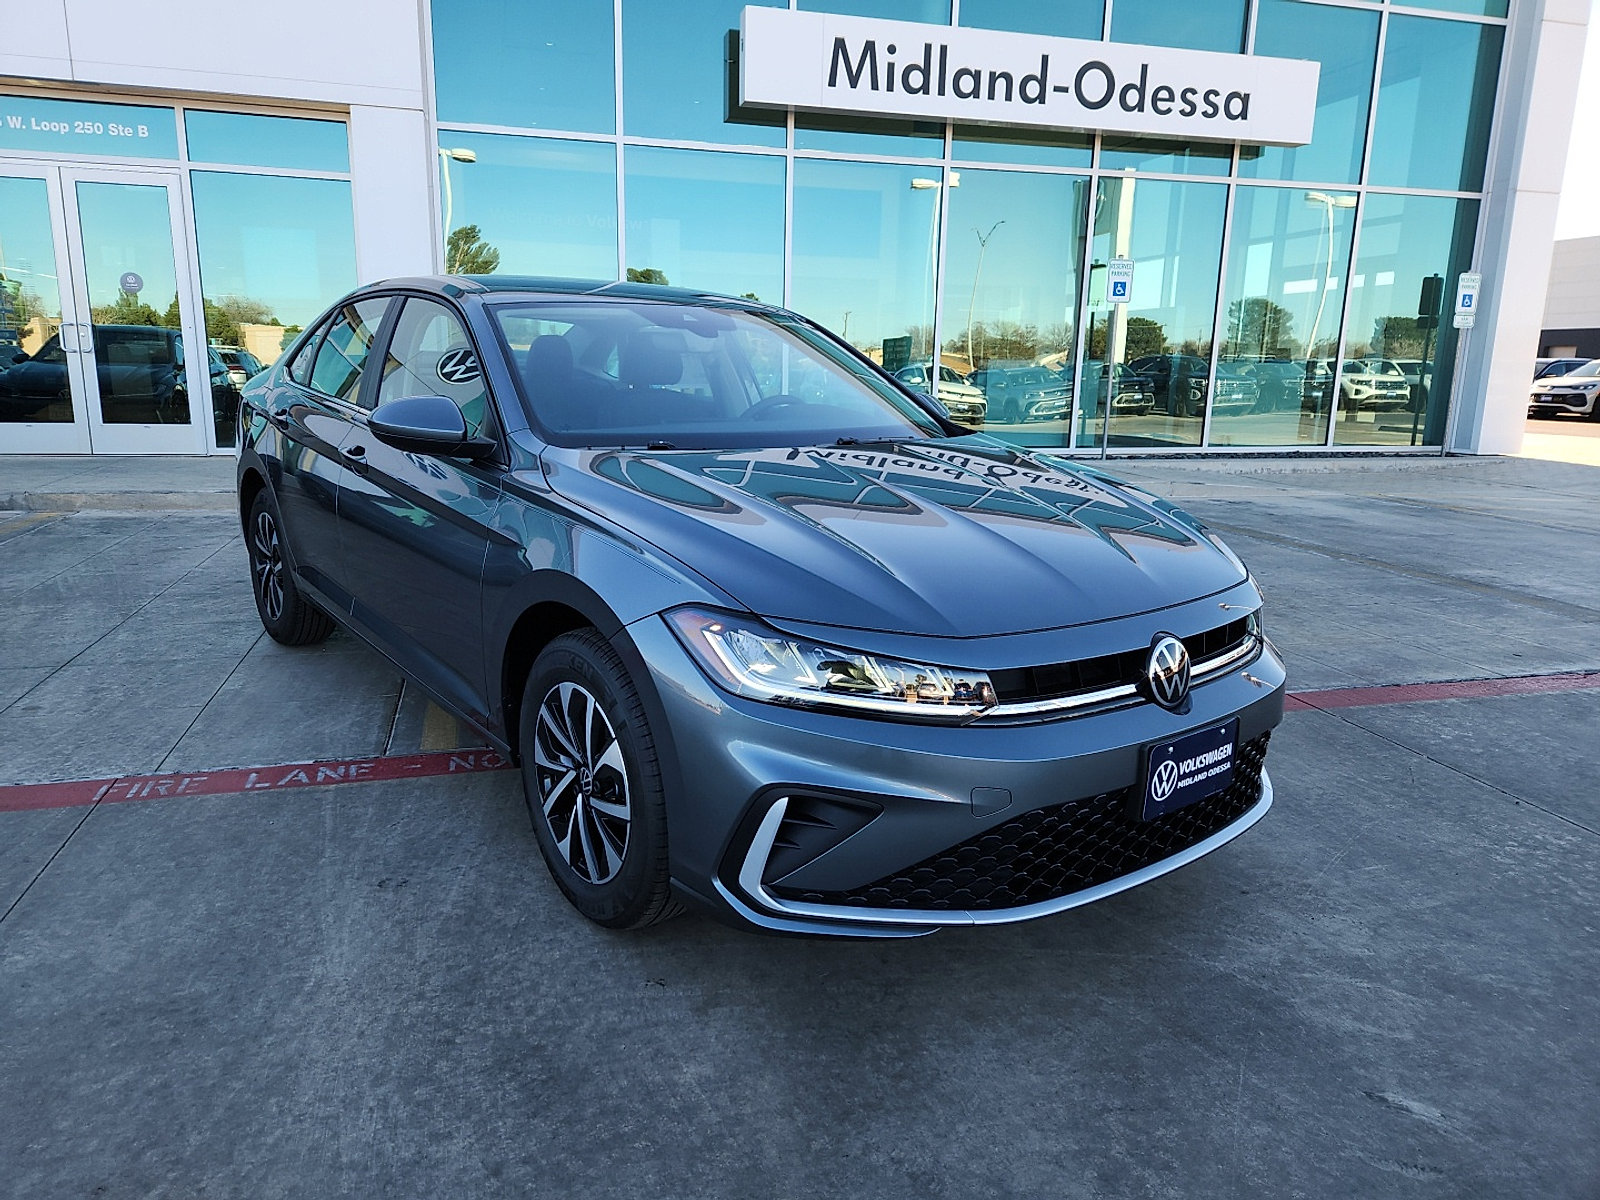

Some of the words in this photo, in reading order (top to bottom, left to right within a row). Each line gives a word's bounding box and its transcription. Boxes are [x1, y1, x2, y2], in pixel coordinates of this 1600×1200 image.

[827, 36, 1250, 122] Midland-Odessa
[6, 115, 26, 129] W.
[31, 117, 69, 134] Loop
[74, 121, 104, 135] 250
[108, 123, 133, 137] Ste
[137, 125, 149, 138] B
[1177, 771, 1208, 789] MIDLAND
[1207, 761, 1232, 777] ODESSA
[1179, 742, 1233, 776] VOLKSWAGEN
[92, 776, 208, 801] FIRE
[244, 763, 375, 790] LANE
[449, 753, 506, 771] NO
